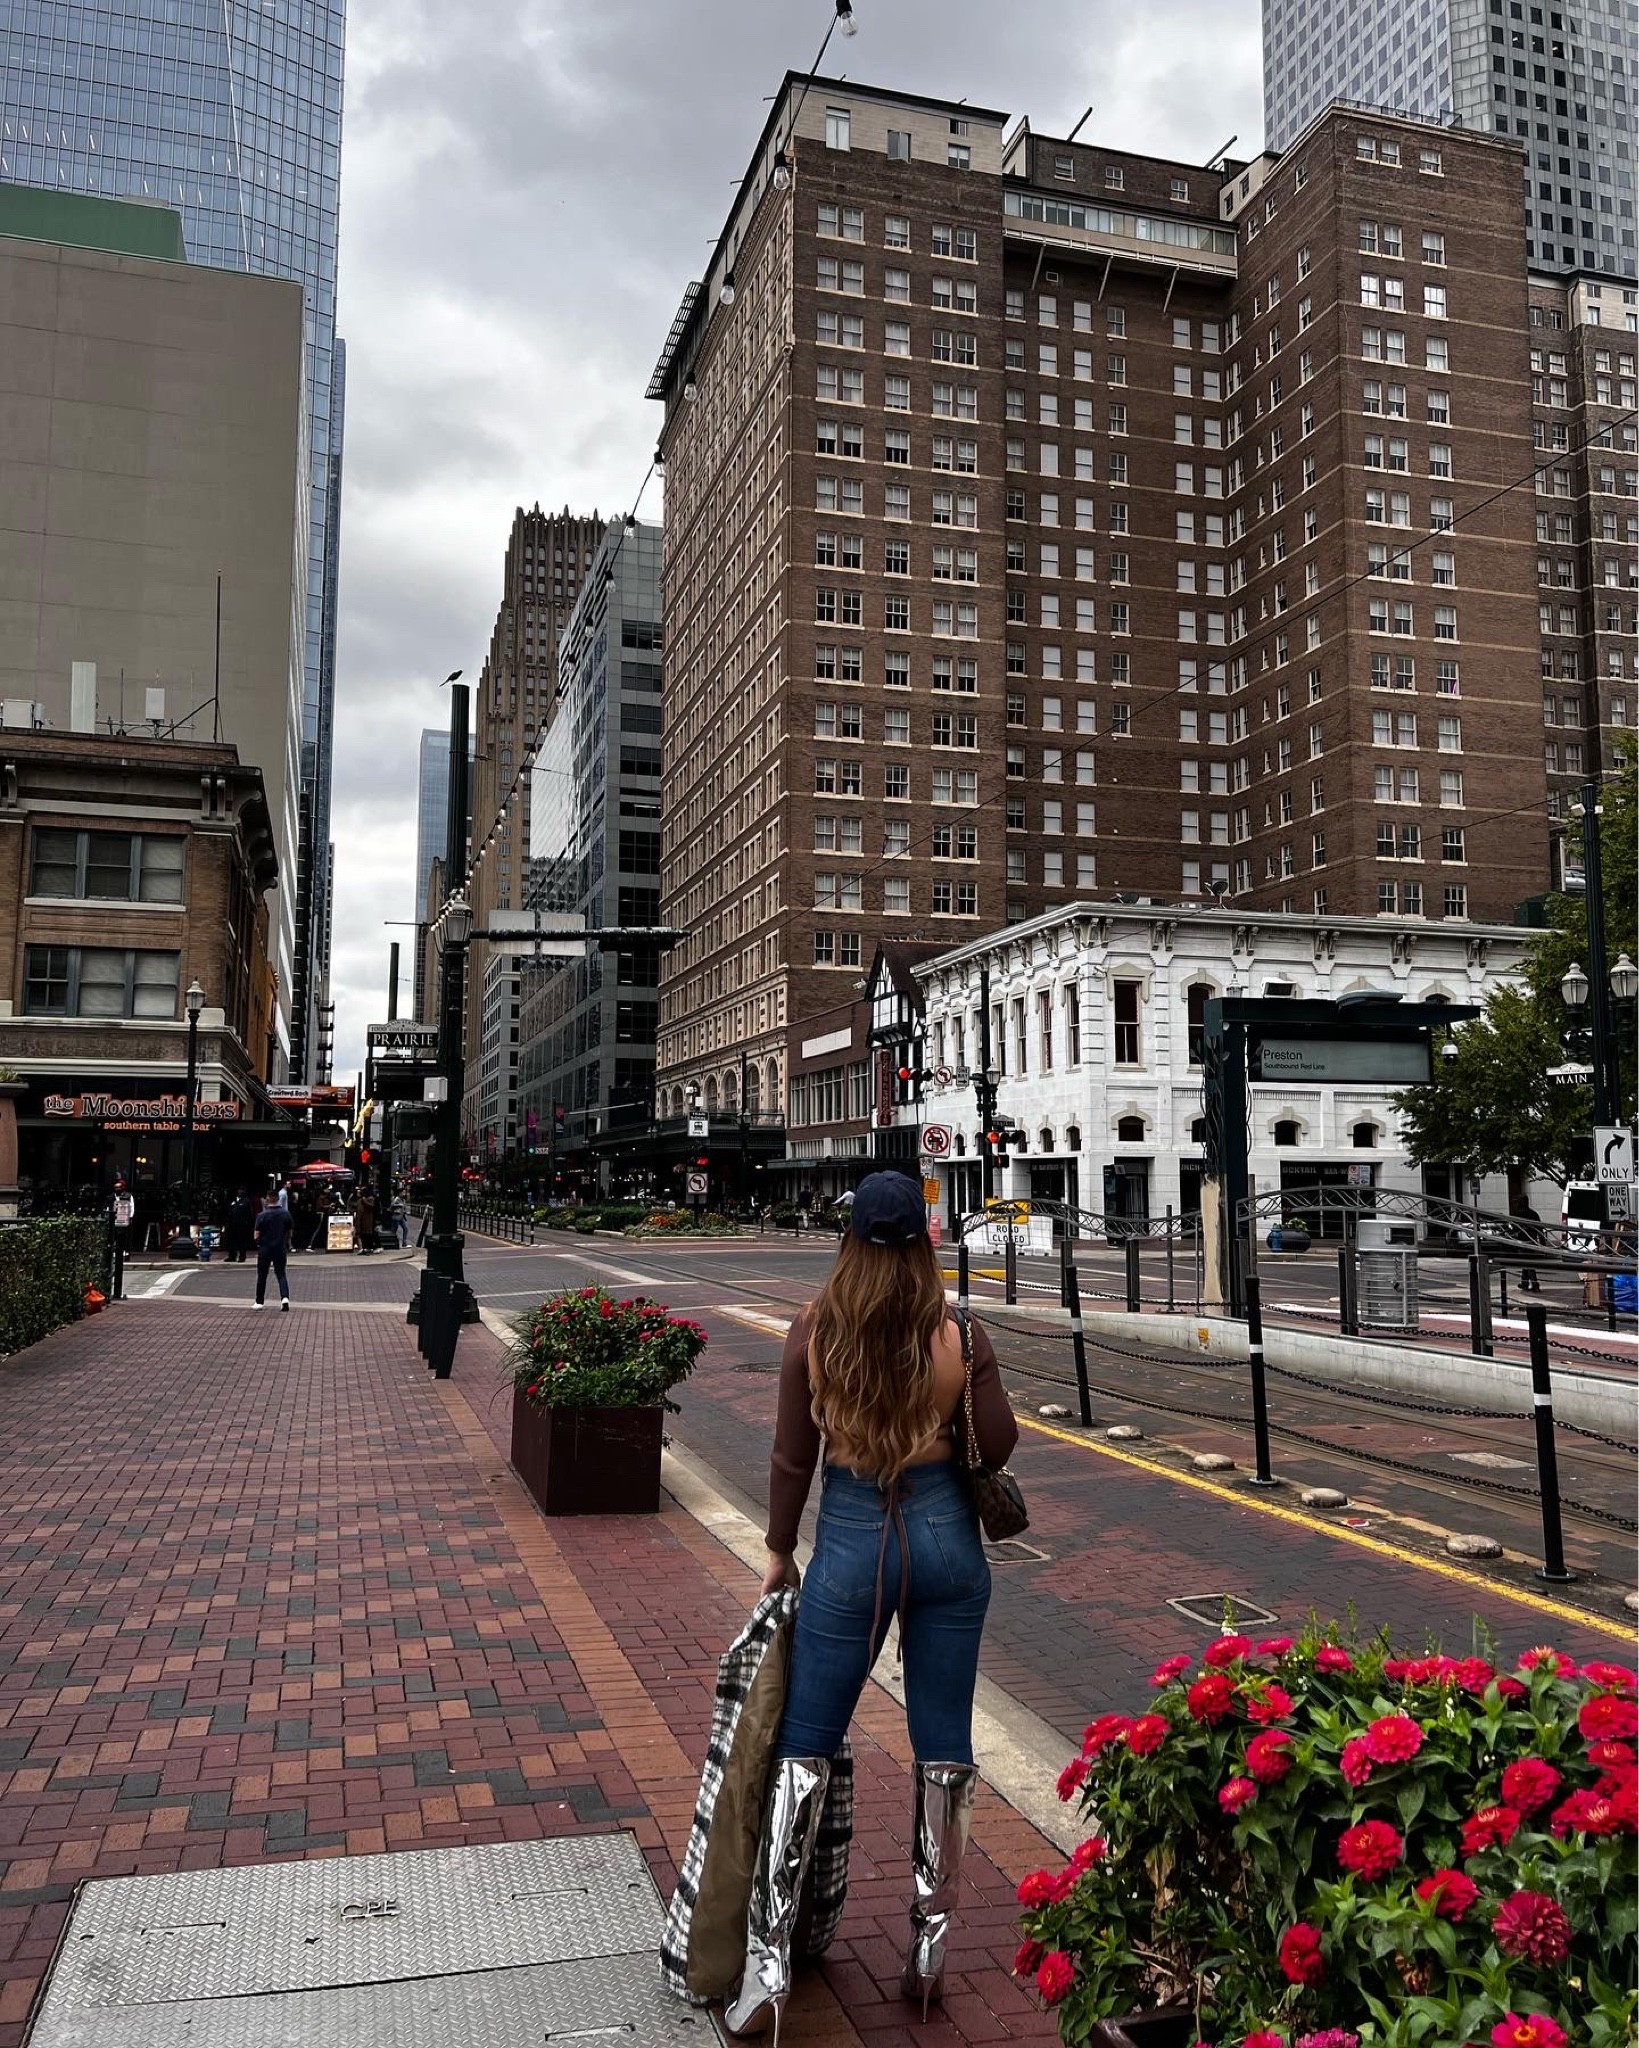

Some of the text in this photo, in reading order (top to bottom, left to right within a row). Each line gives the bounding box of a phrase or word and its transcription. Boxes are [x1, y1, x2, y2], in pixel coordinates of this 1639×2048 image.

[373, 1033, 433, 1046] PRAIRIE
[1263, 1049, 1303, 1060] Preston
[1556, 1074, 1588, 1085] MAIN
[45, 1096, 237, 1117] the Moonshiners
[103, 1121, 210, 1131] southern table bar
[1602, 1167, 1628, 1178] ONLY
[1609, 1187, 1626, 1196] ONE
[1609, 1197, 1627, 1207] WAY
[996, 1225, 1019, 1234] ROD
[992, 1234, 1025, 1243] CLOED
